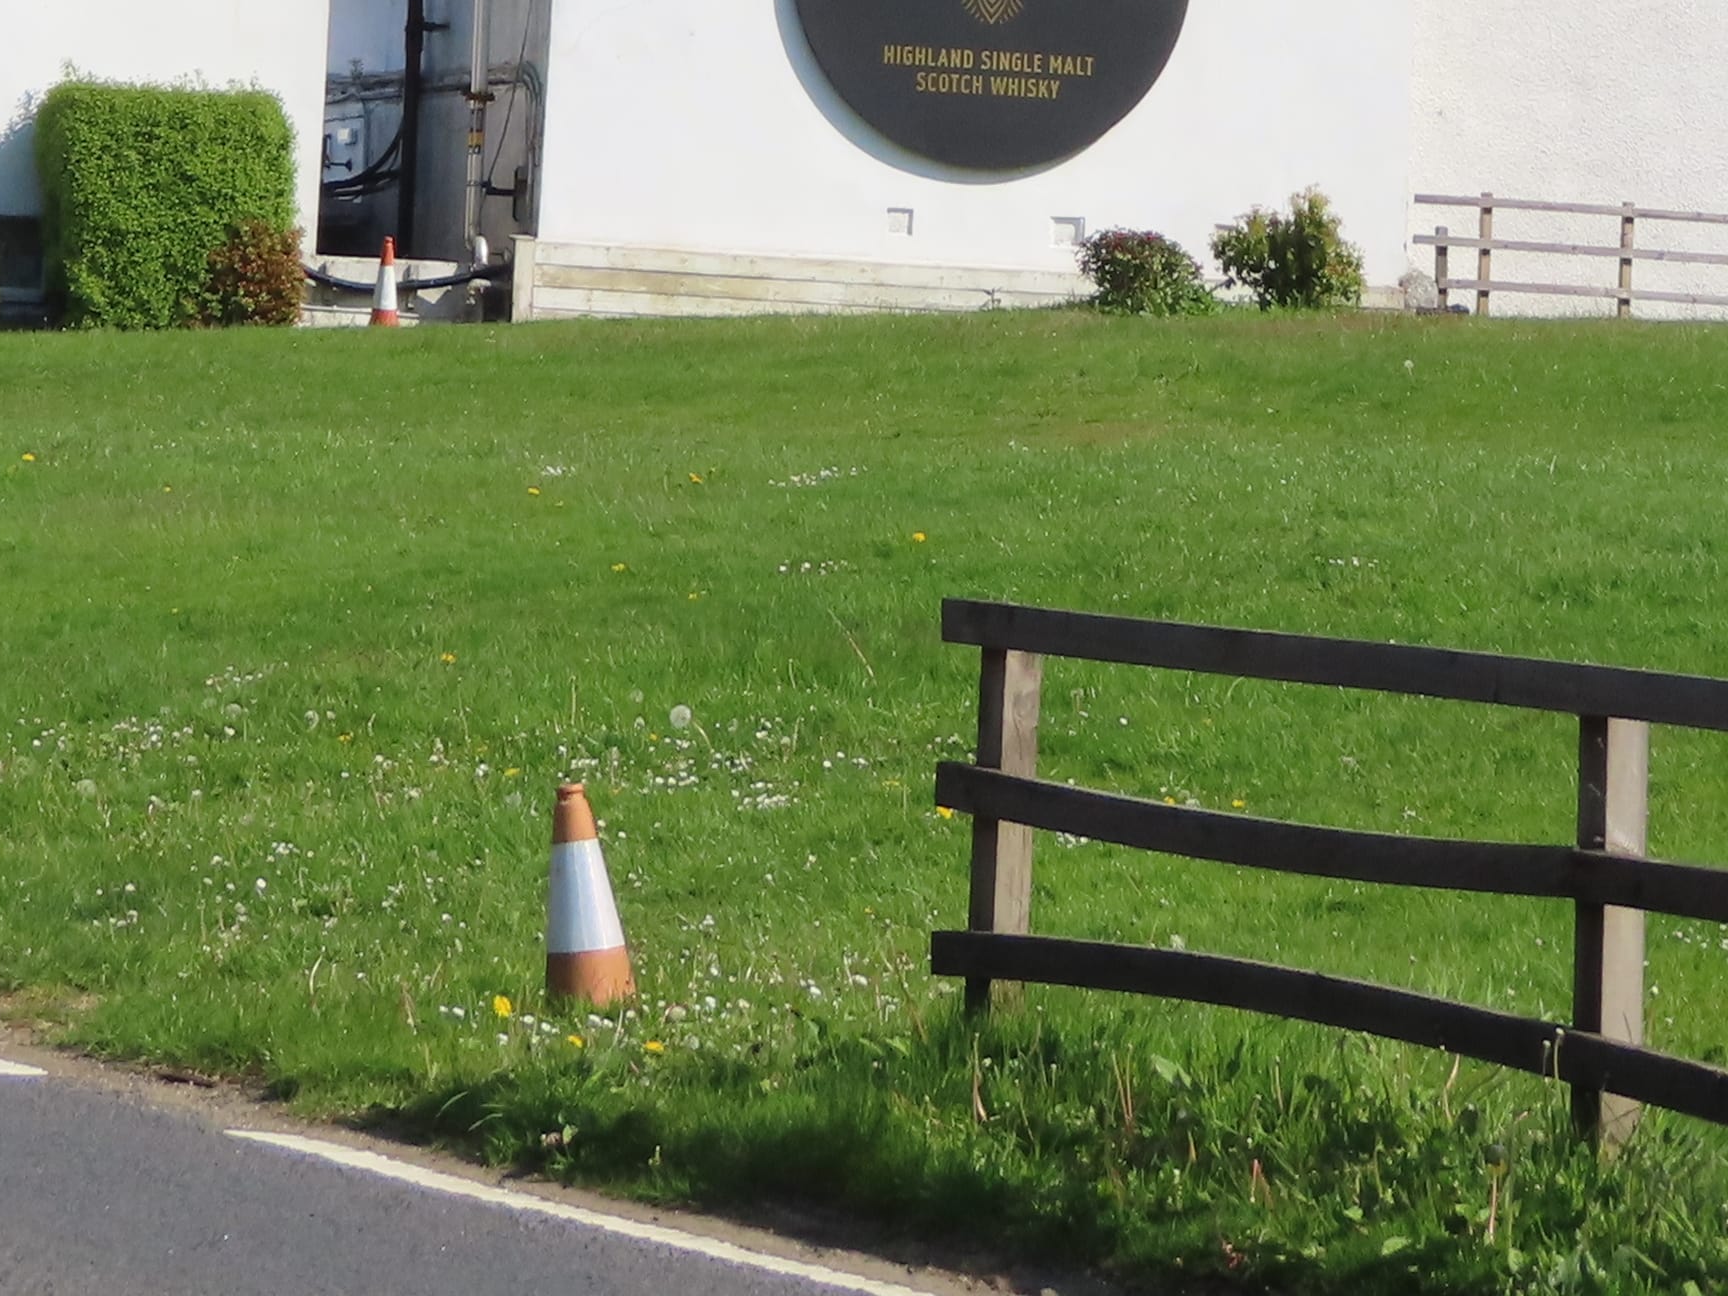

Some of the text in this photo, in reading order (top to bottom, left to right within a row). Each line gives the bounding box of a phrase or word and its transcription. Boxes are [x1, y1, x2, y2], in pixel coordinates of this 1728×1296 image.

[883, 45, 1095, 77] HIGHLAND SINGLE MALT
[915, 72, 1060, 100] SCOTCH WHISKY
